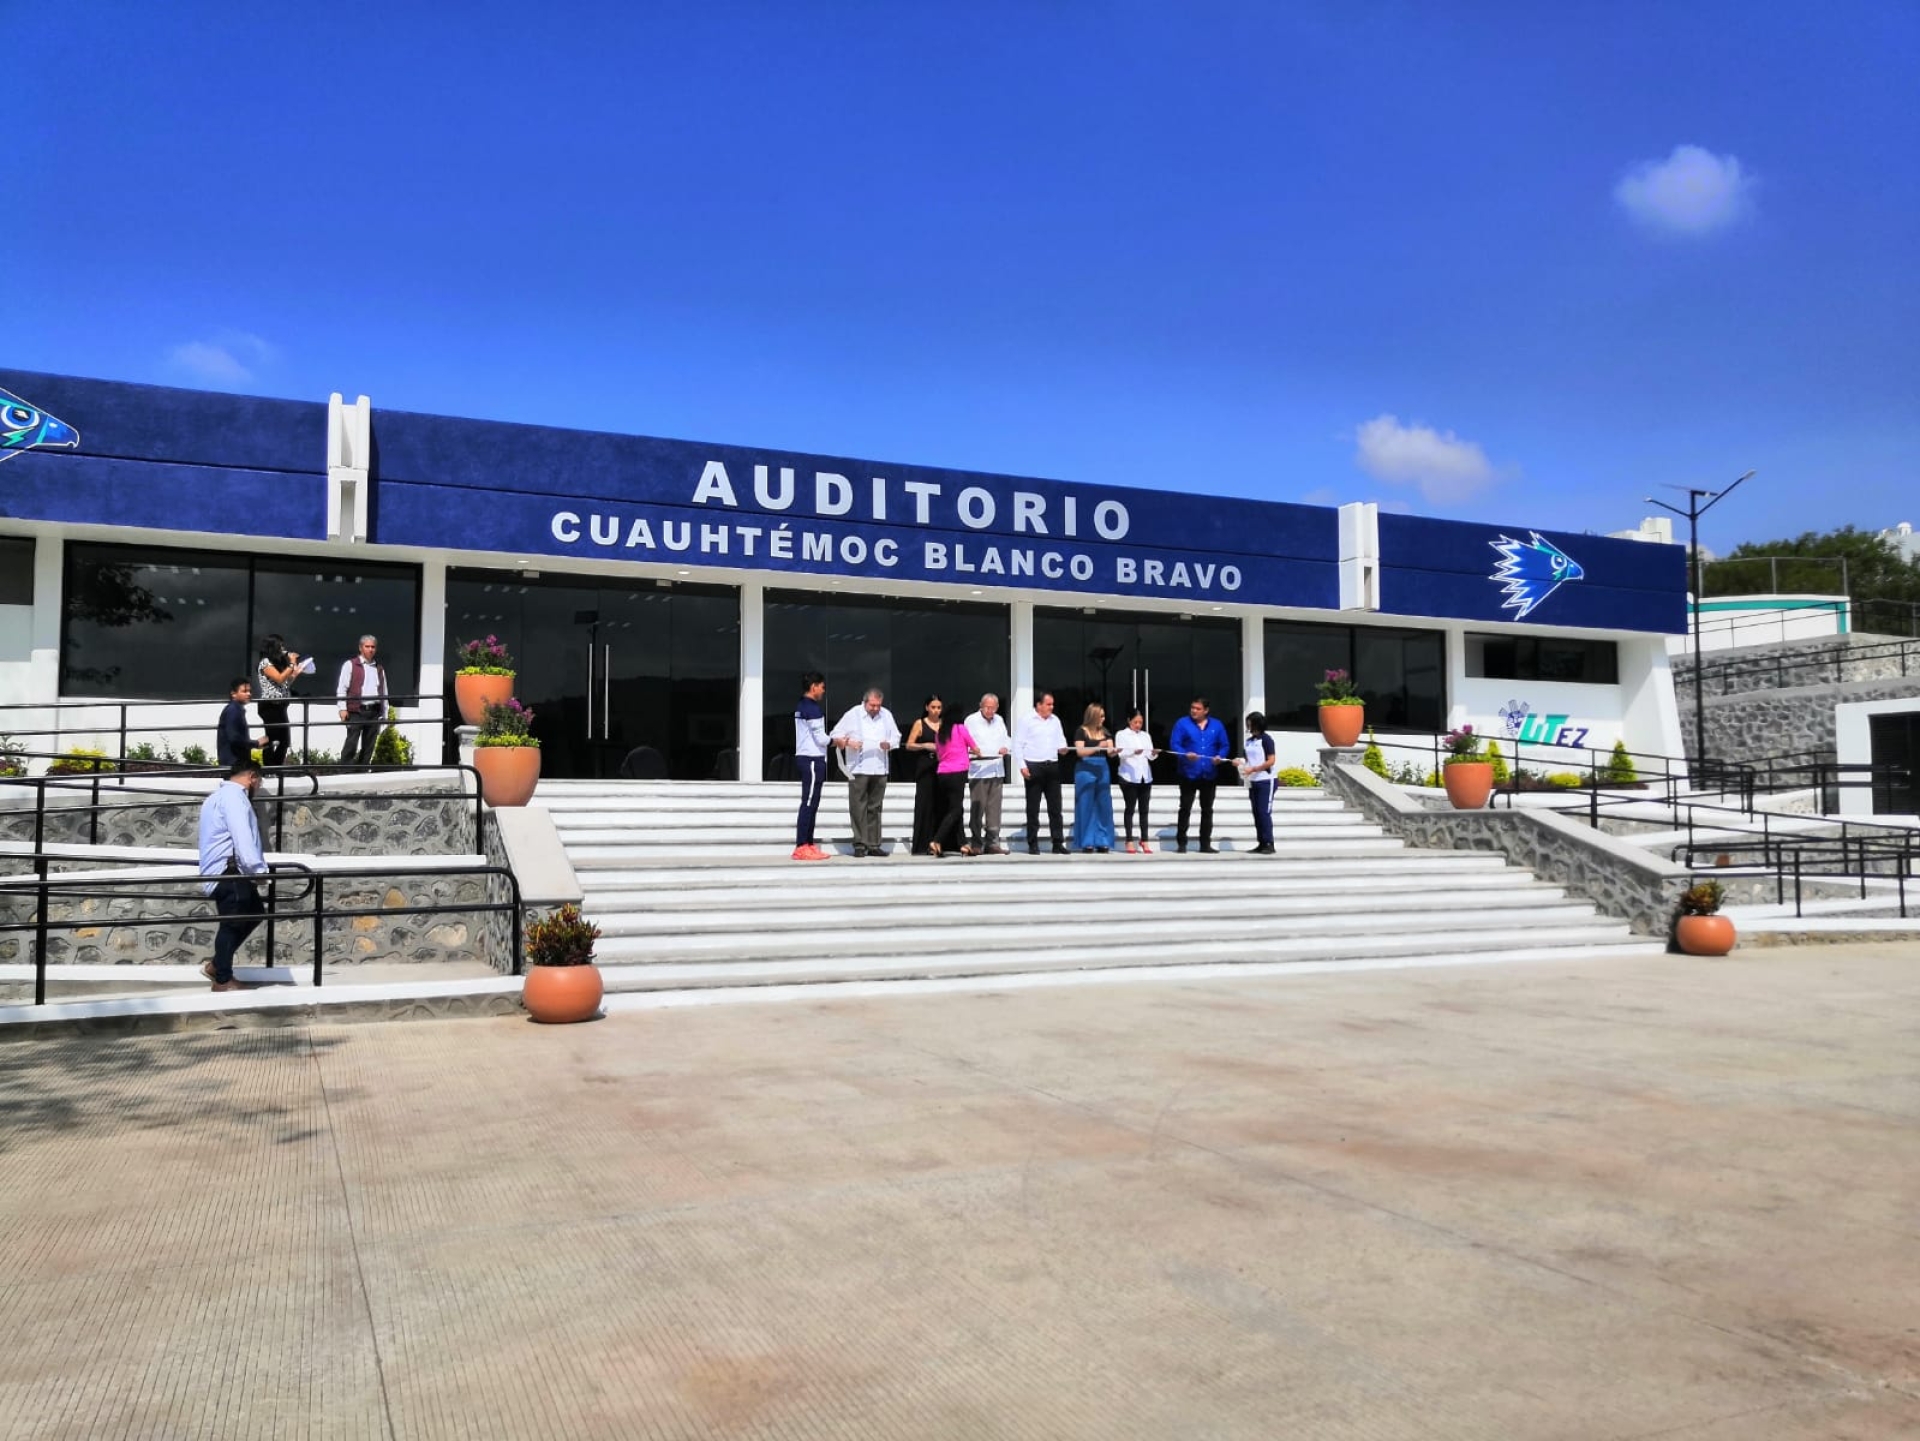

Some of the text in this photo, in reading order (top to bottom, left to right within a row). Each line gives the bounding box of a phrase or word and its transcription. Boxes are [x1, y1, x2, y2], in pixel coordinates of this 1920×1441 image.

[692, 460, 1130, 540] AUDITORIO
[551, 511, 1242, 591] CUAUHTÉMOC BLANCO BRAVO
[1519, 713, 1589, 748] UTEZ
